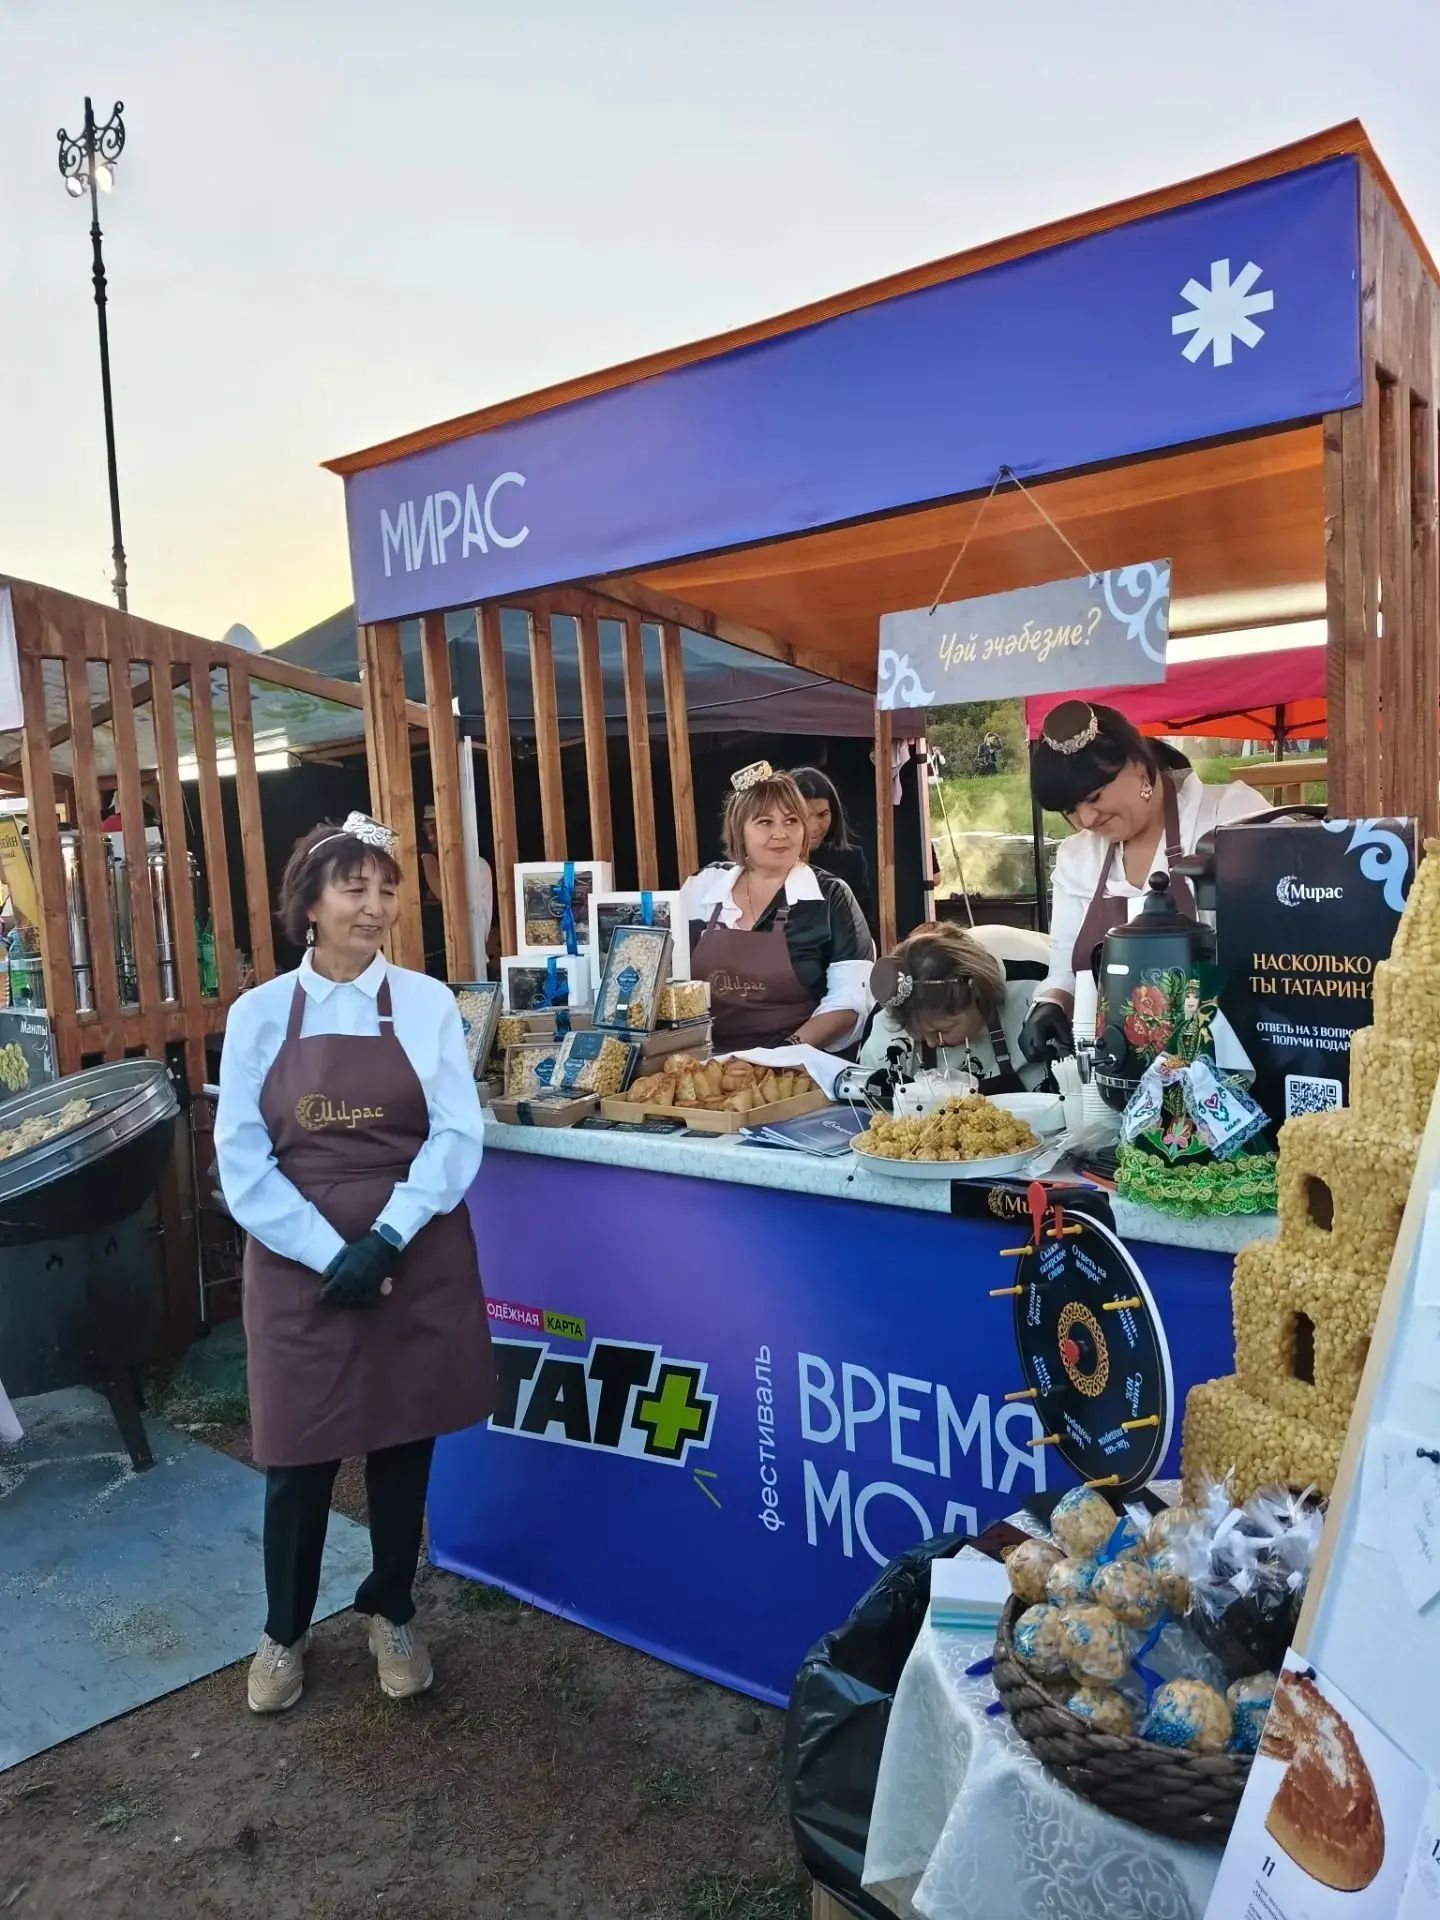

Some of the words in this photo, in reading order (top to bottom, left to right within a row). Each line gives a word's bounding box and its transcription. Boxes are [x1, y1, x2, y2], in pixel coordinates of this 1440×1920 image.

[380, 471, 530, 577] МИРАС
[1290, 882, 1343, 903] Мирас
[1252, 952, 1372, 975] НАСКОЛЬКО
[1249, 976, 1277, 994] ТЫ
[20, 1021, 48, 1036] Манты
[1256, 1021, 1293, 1035] ОТВЕТЬ
[1295, 1025, 1310, 1036] НА
[1312, 1025, 1318, 1036] 3
[1320, 1026, 1357, 1039] ВОПРО
[1272, 1035, 1314, 1050] ПОЛУЧИ
[1315, 1038, 1351, 1053] ПОДАР
[1071, 1244, 1097, 1271] Ответь
[486, 1302, 540, 1327] ОДЁЖНАЯ
[547, 1316, 583, 1336] КАРТА
[798, 1351, 1047, 1494] ВРЕМЯ
[752, 1344, 785, 1532] фестиваль
[1262, 1855, 1276, 1877] 11
